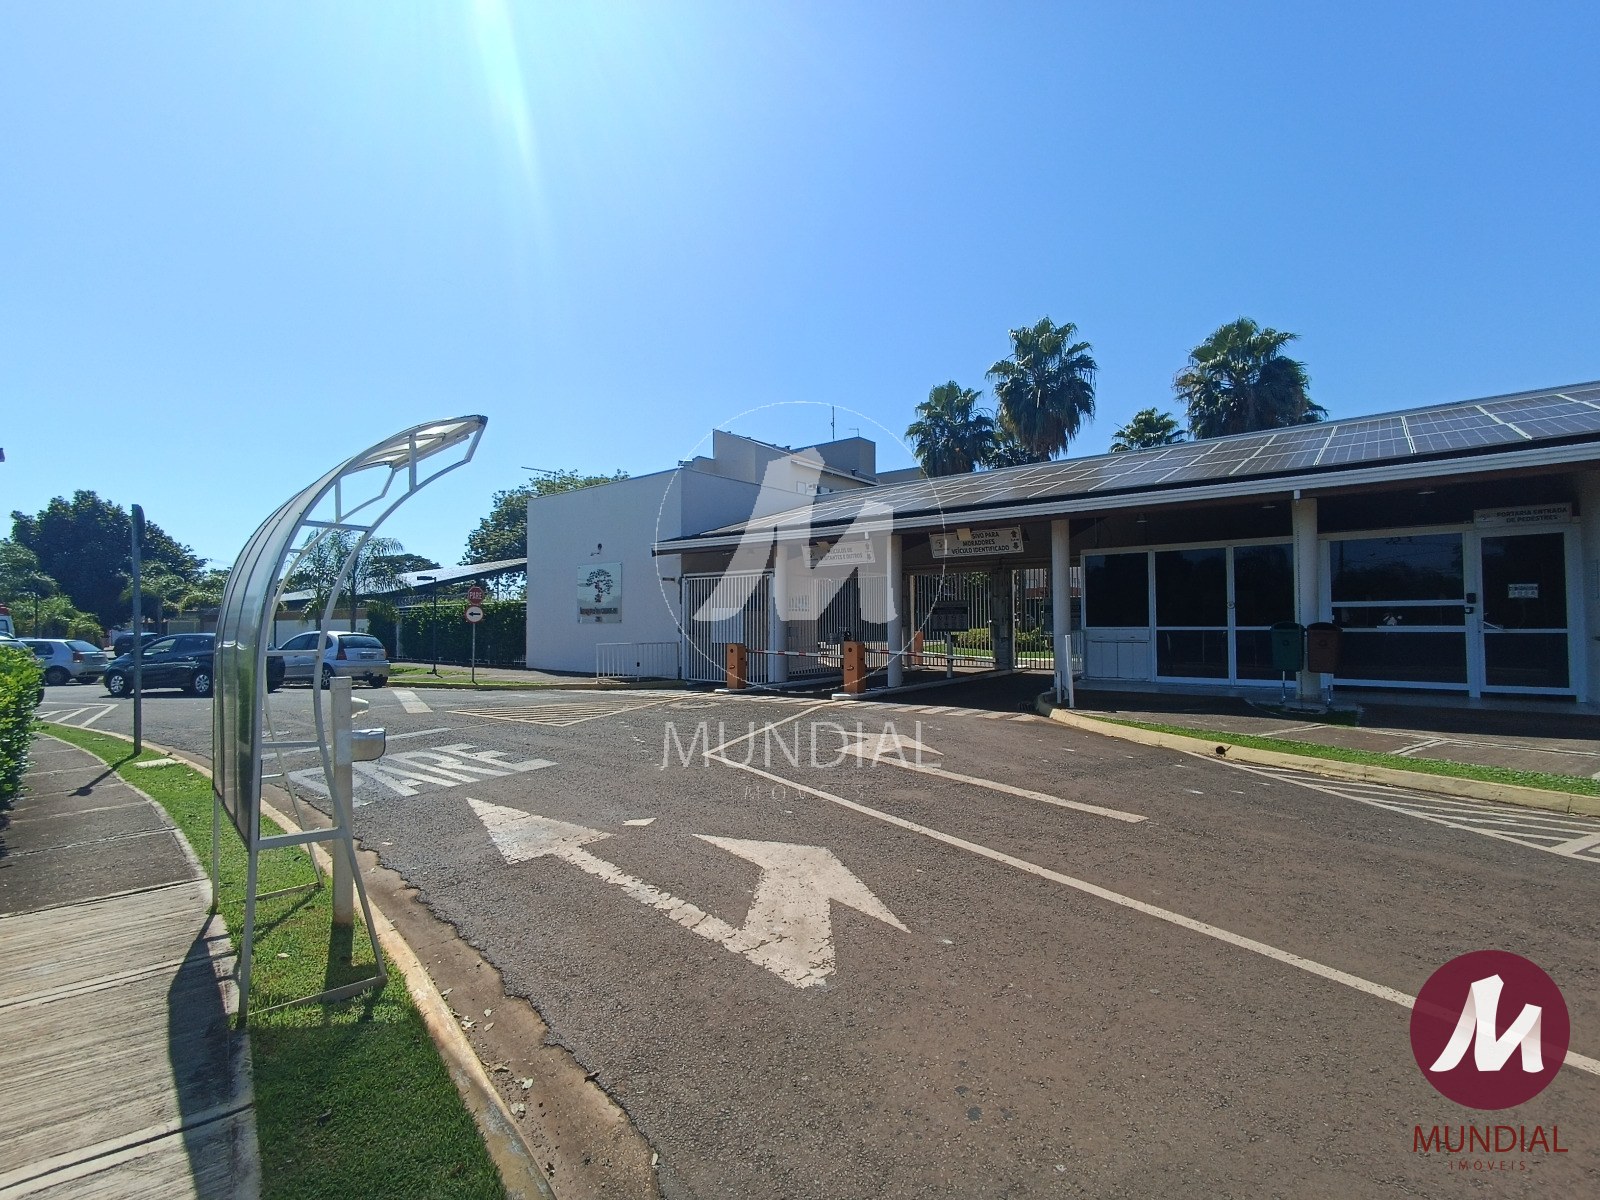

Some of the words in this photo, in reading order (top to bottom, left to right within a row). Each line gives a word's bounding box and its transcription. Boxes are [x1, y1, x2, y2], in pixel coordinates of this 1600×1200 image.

[985, 531, 999, 539] PARA
[962, 539, 995, 547] MORADORES
[951, 546, 973, 554] VEÍCULO
[973, 544, 1010, 553] IDENTIFICADO
[470, 591, 482, 600] PARE
